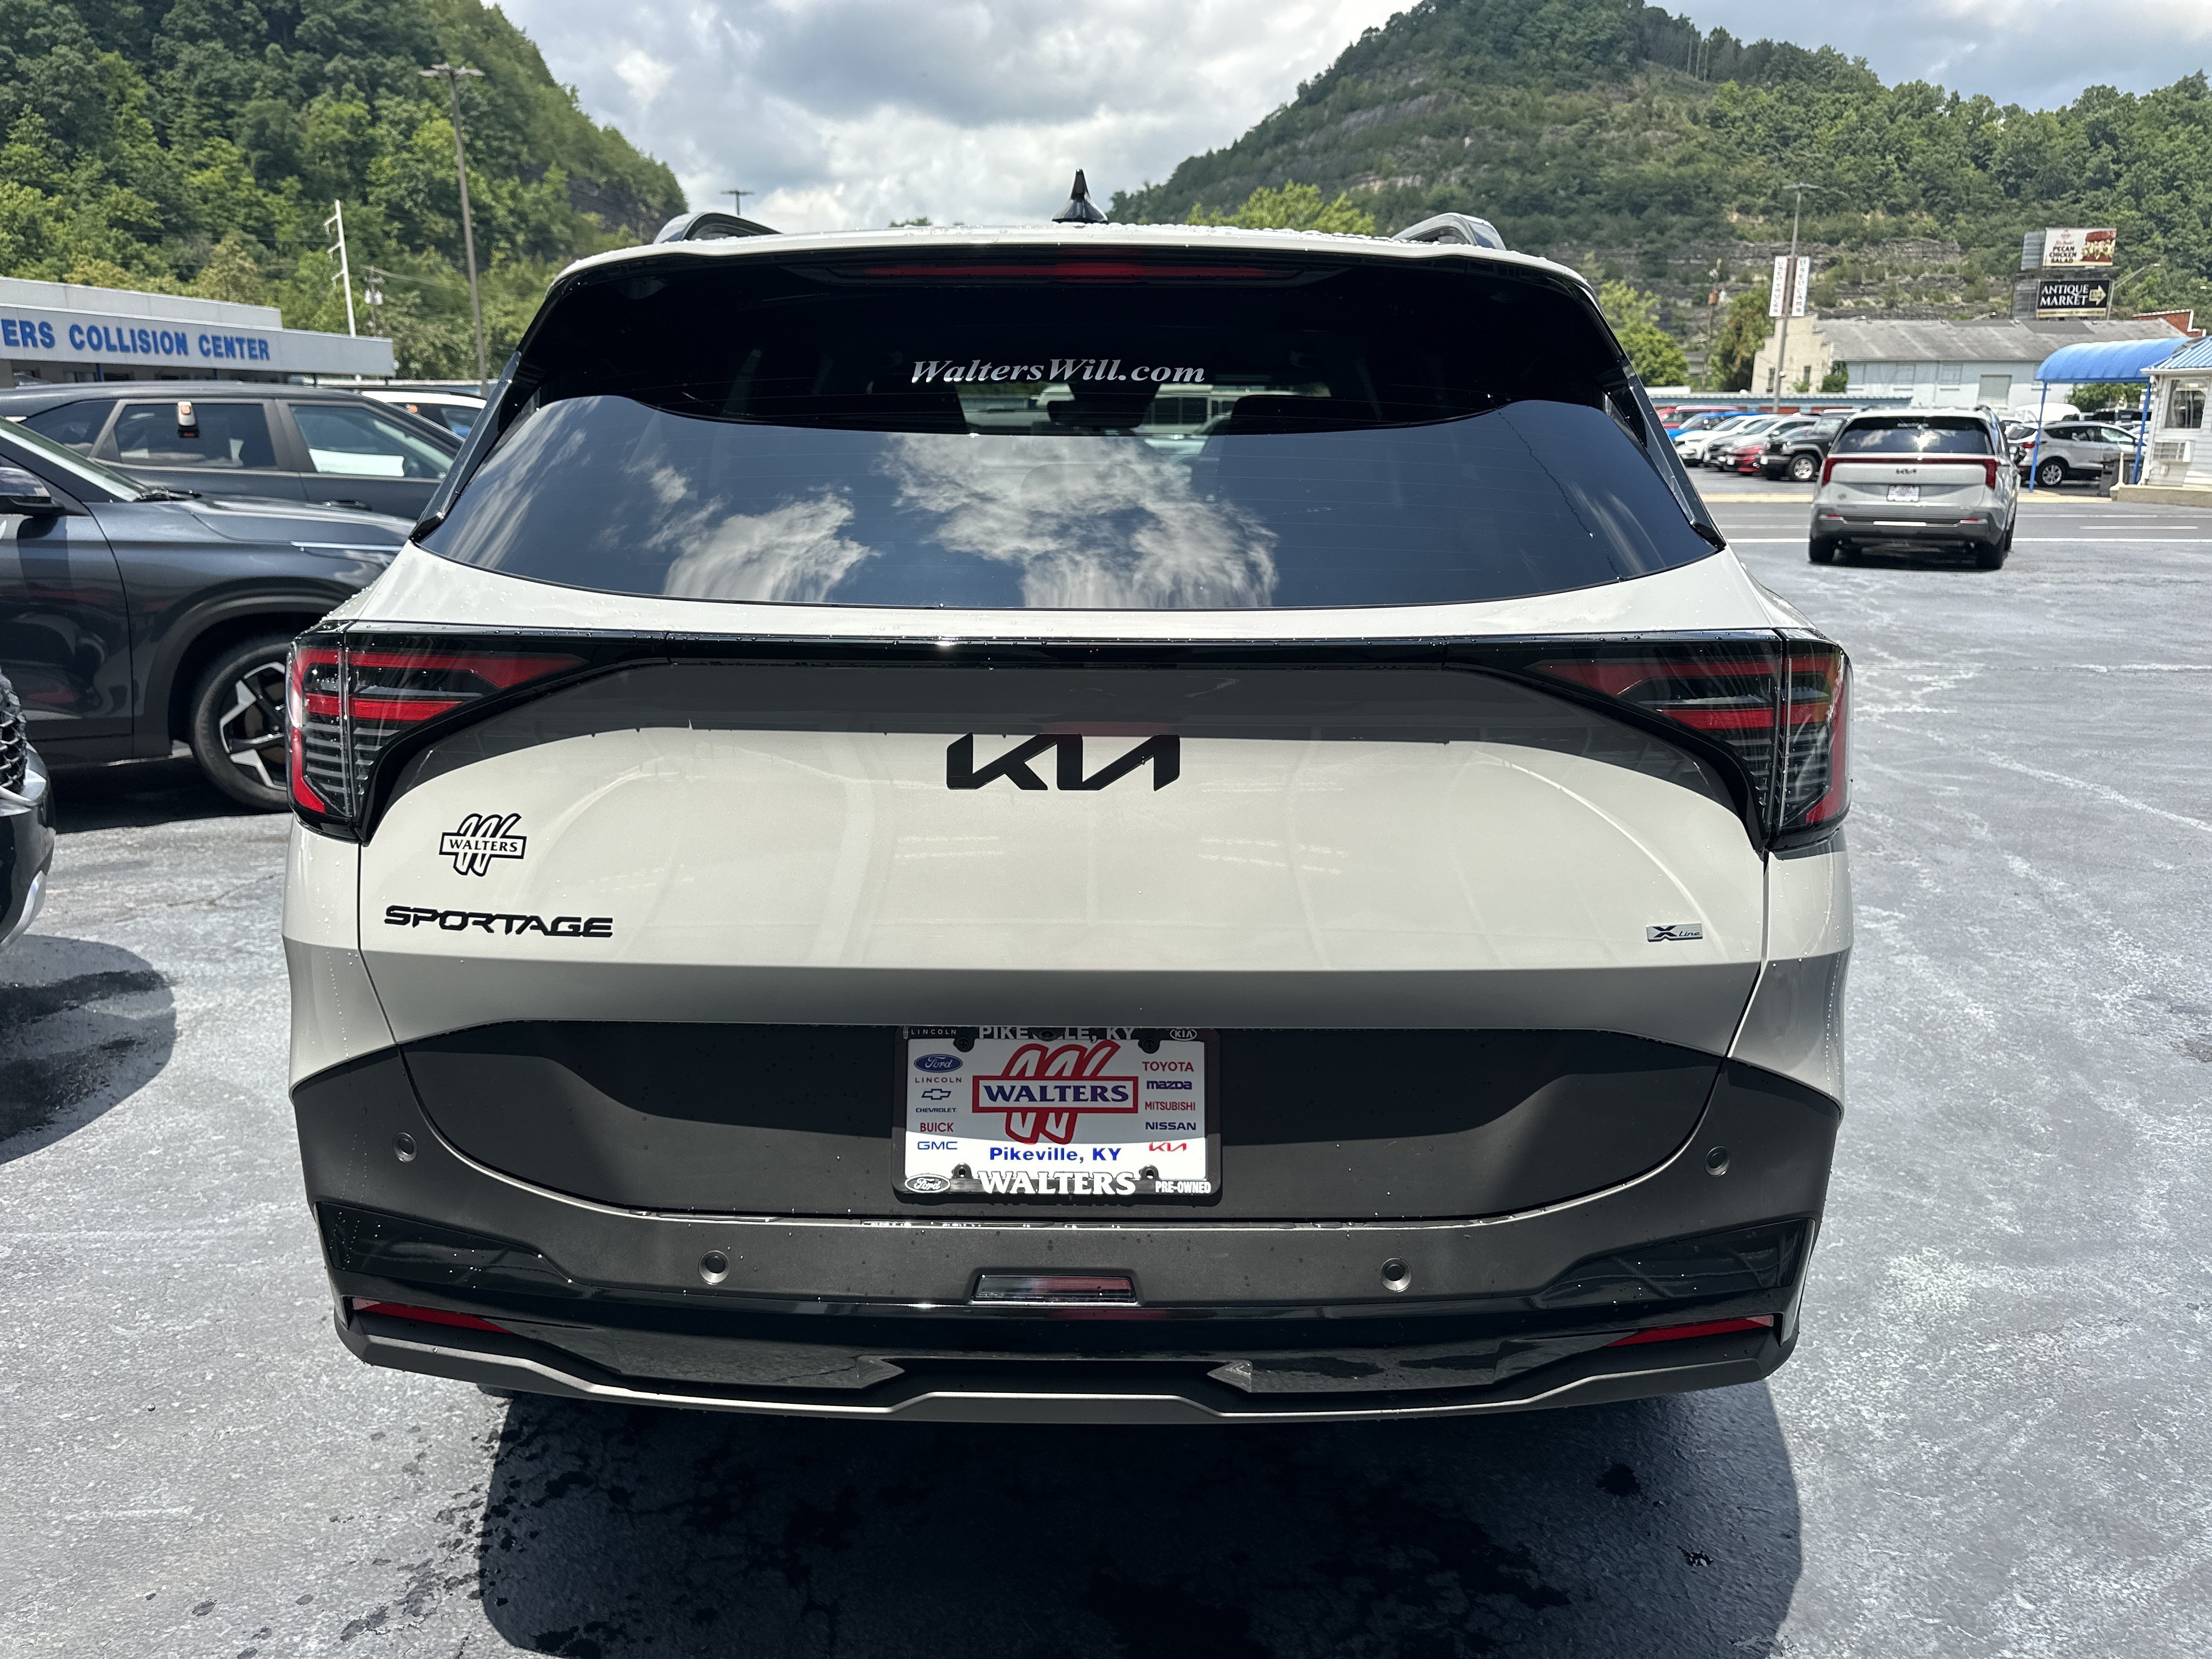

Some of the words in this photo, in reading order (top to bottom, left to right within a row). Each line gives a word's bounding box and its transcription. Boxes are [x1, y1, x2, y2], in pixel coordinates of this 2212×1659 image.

[2041, 284, 2089, 296] ANTIQUE
[2040, 295, 2088, 306] MARKET
[69, 324, 190, 356] COLLISION
[198, 334, 271, 360] CENTER
[911, 359, 1205, 383] WaltersWill.com
[946, 732, 1180, 791] KIA
[448, 838, 518, 853] WALTERS
[384, 905, 613, 938] SPORTAGE
[1107, 1026, 1135, 1040] KY
[925, 1056, 953, 1068] Ford
[1142, 1062, 1194, 1071] TOYOTA
[983, 1085, 1129, 1102] WALTERS
[1144, 1101, 1196, 1111] MITSUBISHI
[920, 1122, 954, 1132] BUICK
[1145, 1121, 1197, 1130] NISSAN
[917, 1141, 958, 1150] GMC
[990, 1147, 1084, 1163] Pikeville,
[1092, 1147, 1122, 1161] KY
[977, 1171, 1136, 1195] WALTERS
[1155, 1181, 1211, 1194] PRE-OWNED
